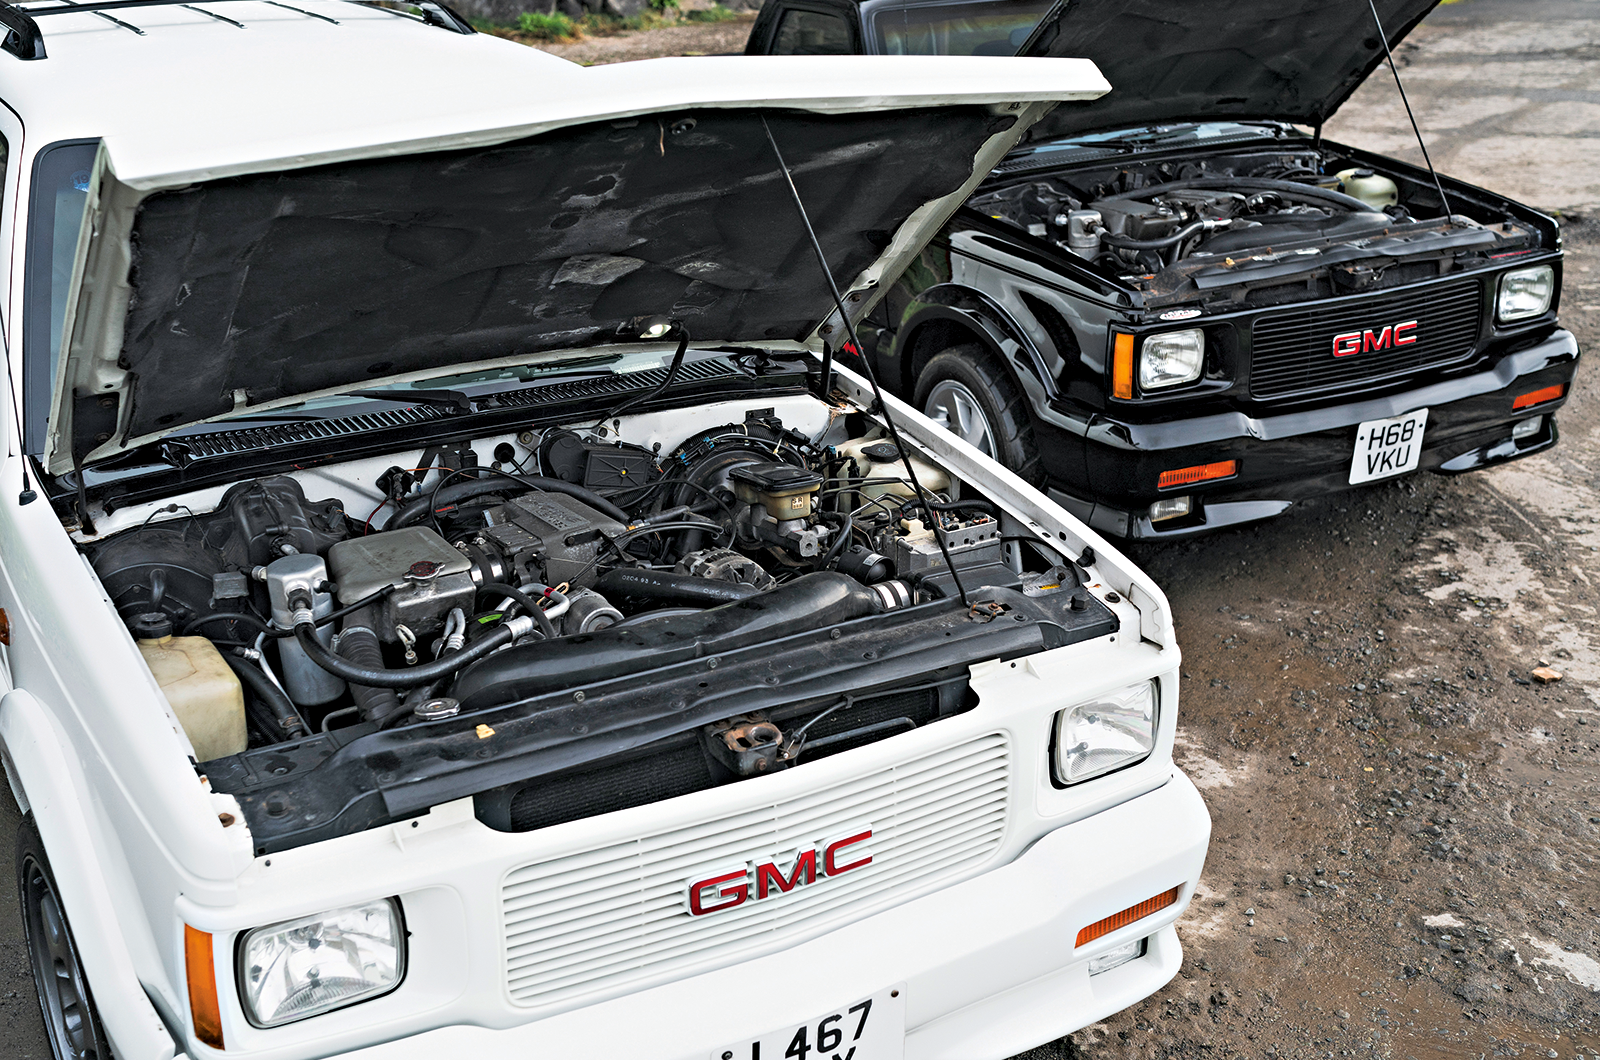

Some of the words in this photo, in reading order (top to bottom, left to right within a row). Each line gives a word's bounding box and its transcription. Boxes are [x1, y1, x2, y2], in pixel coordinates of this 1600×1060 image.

[1332, 319, 1418, 358] GMC
[1368, 418, 1416, 450] H68
[1367, 444, 1411, 475] VKU
[686, 823, 873, 917] GMC
